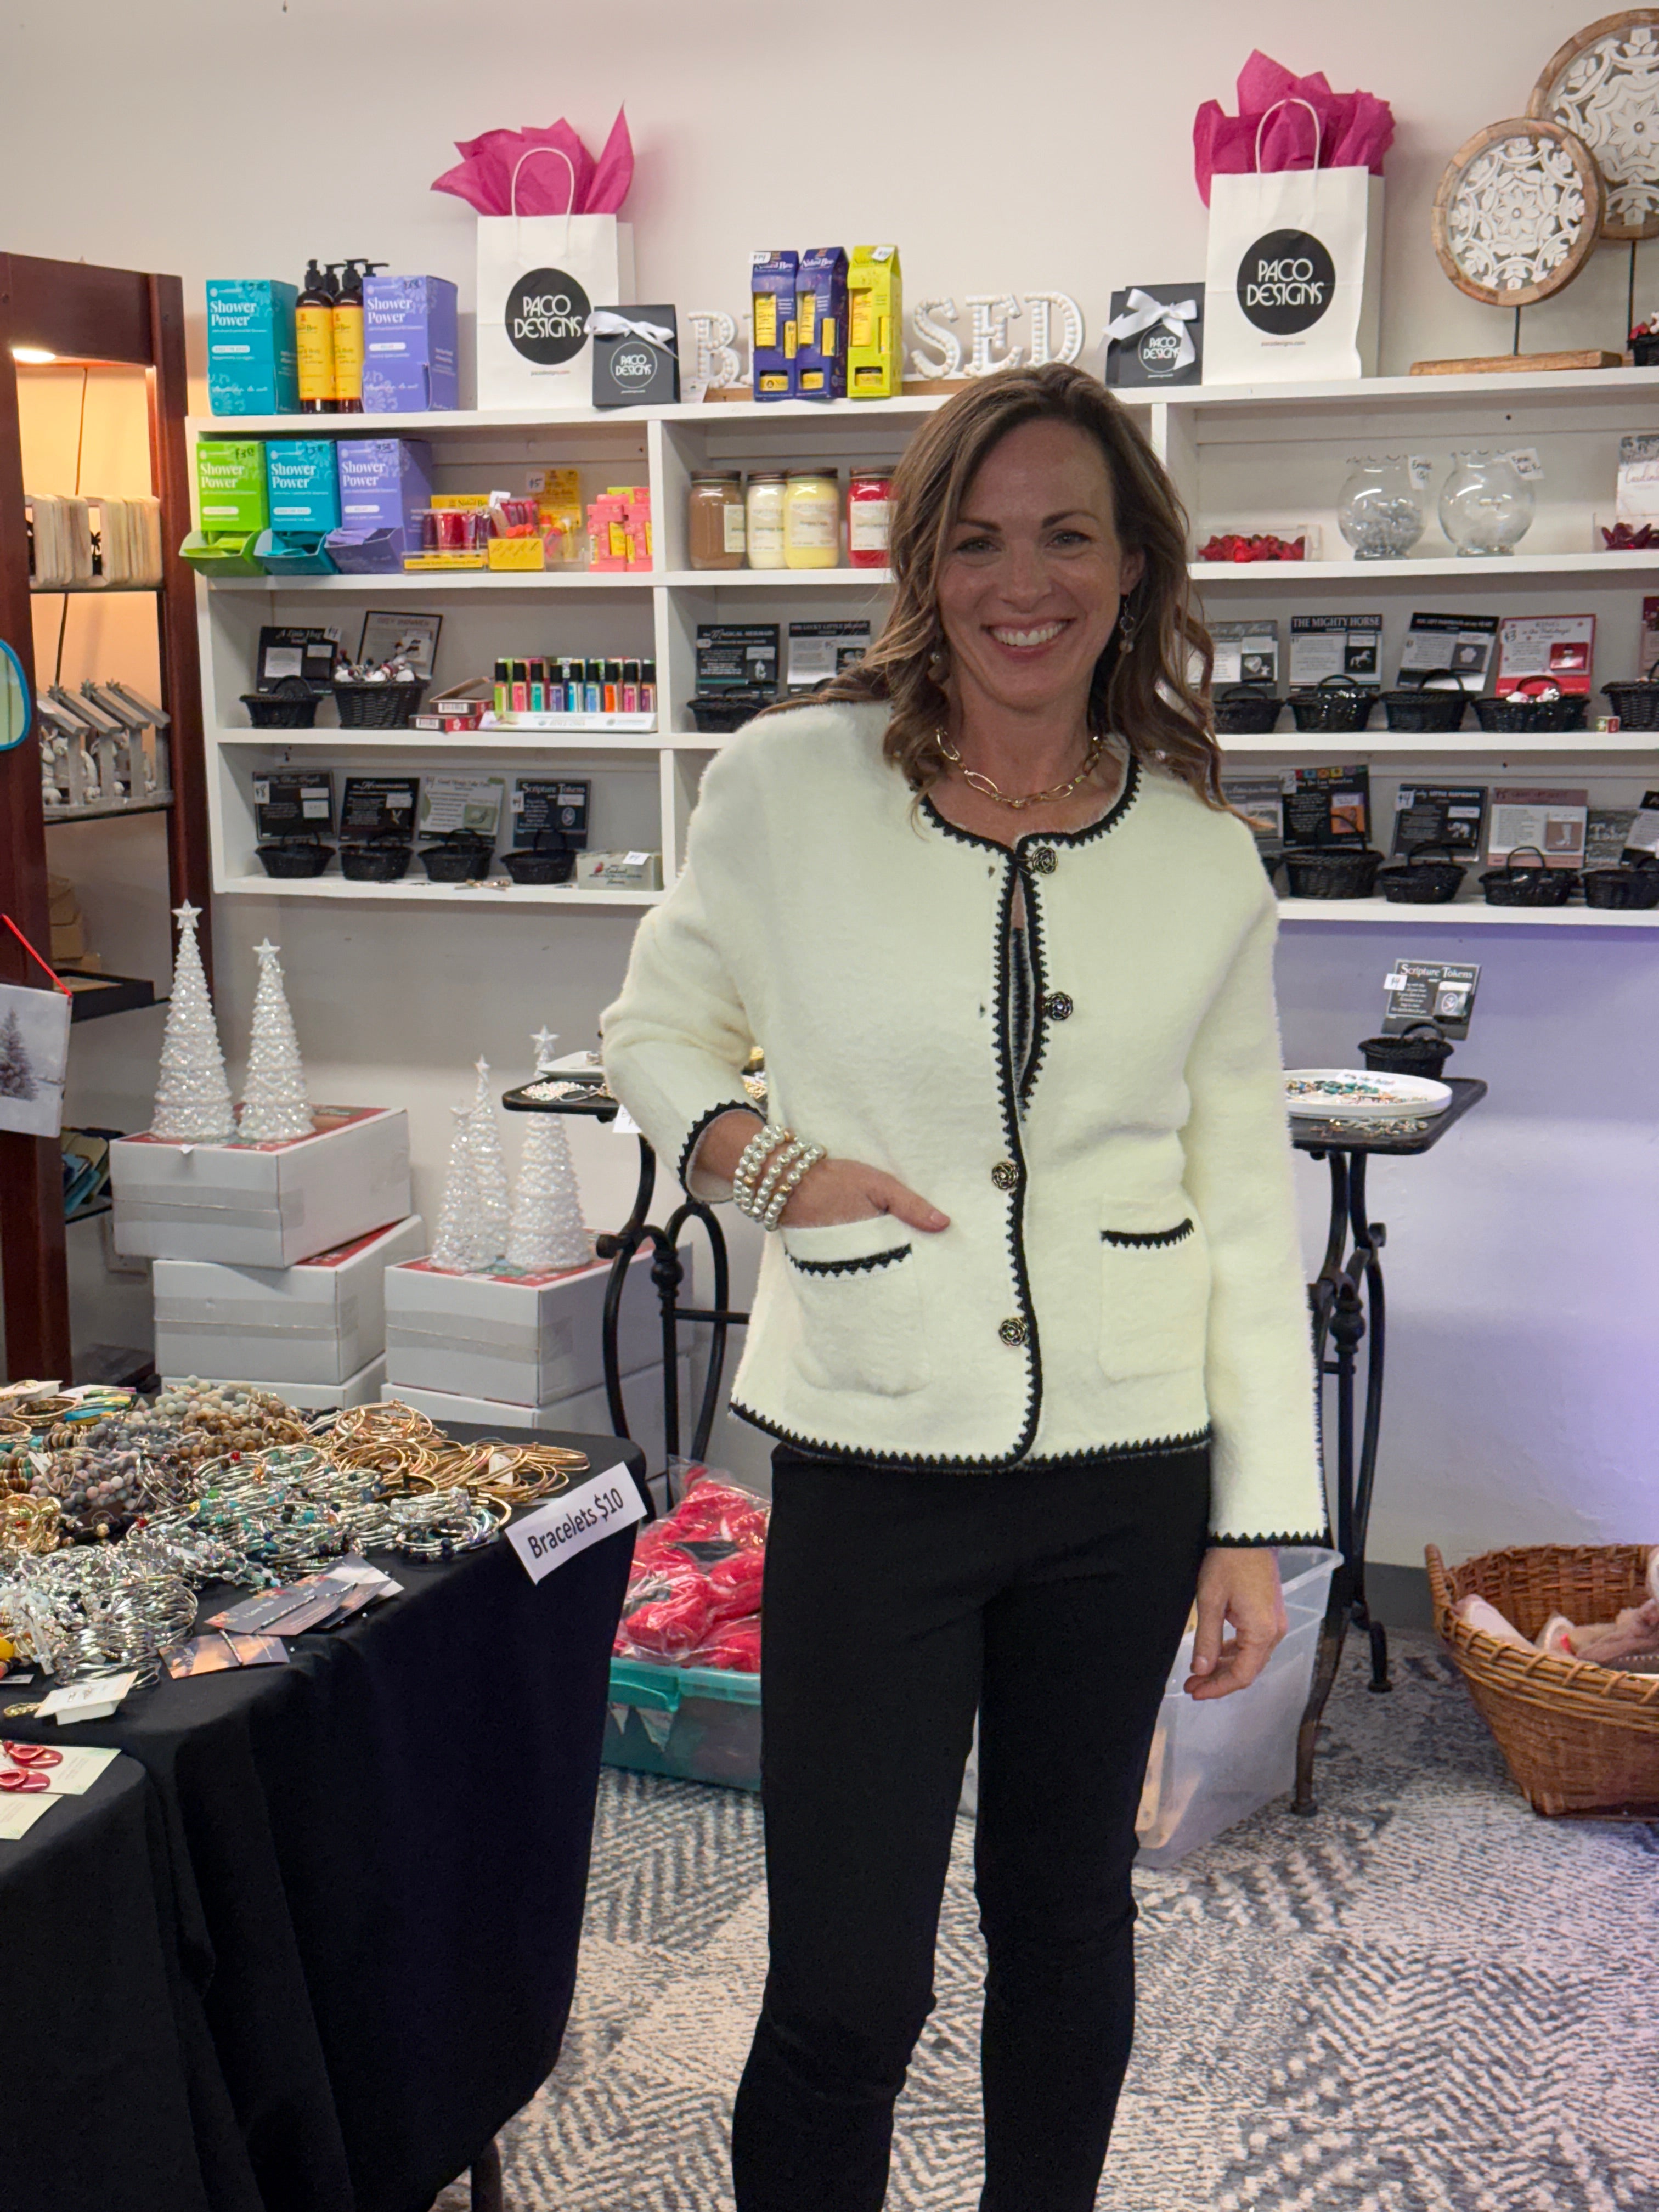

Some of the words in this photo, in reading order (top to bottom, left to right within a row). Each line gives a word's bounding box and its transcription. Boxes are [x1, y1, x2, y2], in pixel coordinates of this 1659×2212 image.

[1258, 258, 1313, 283] PACO
[1246, 281, 1324, 306] DESIGNS
[210, 300, 257, 313] Shower
[367, 297, 412, 311] Shower
[523, 295, 571, 317] PACO
[211, 314, 250, 326] Power
[368, 312, 406, 324] Power
[514, 317, 582, 339] DESIGNS
[1149, 337, 1177, 349] PACO
[620, 354, 648, 365] PACO
[1143, 346, 1181, 360] DESIGNS
[616, 364, 652, 377] DESIGNS
[200, 462, 244, 476] Shower
[271, 463, 317, 476] Shower
[342, 461, 386, 473] Shower
[201, 476, 238, 488] Power
[272, 476, 311, 488] Power
[343, 475, 379, 487] Power
[1293, 618, 1310, 628] THE
[1311, 617, 1348, 627] MIGHTY
[1350, 616, 1381, 627] HORSE
[522, 783, 557, 794] Scripture
[558, 783, 585, 794] Tokens
[1400, 963, 1440, 977] Scripture
[1442, 966, 1473, 979] Tokens
[527, 1509, 597, 1559] Bracelets
[594, 1487, 624, 1522] $10
